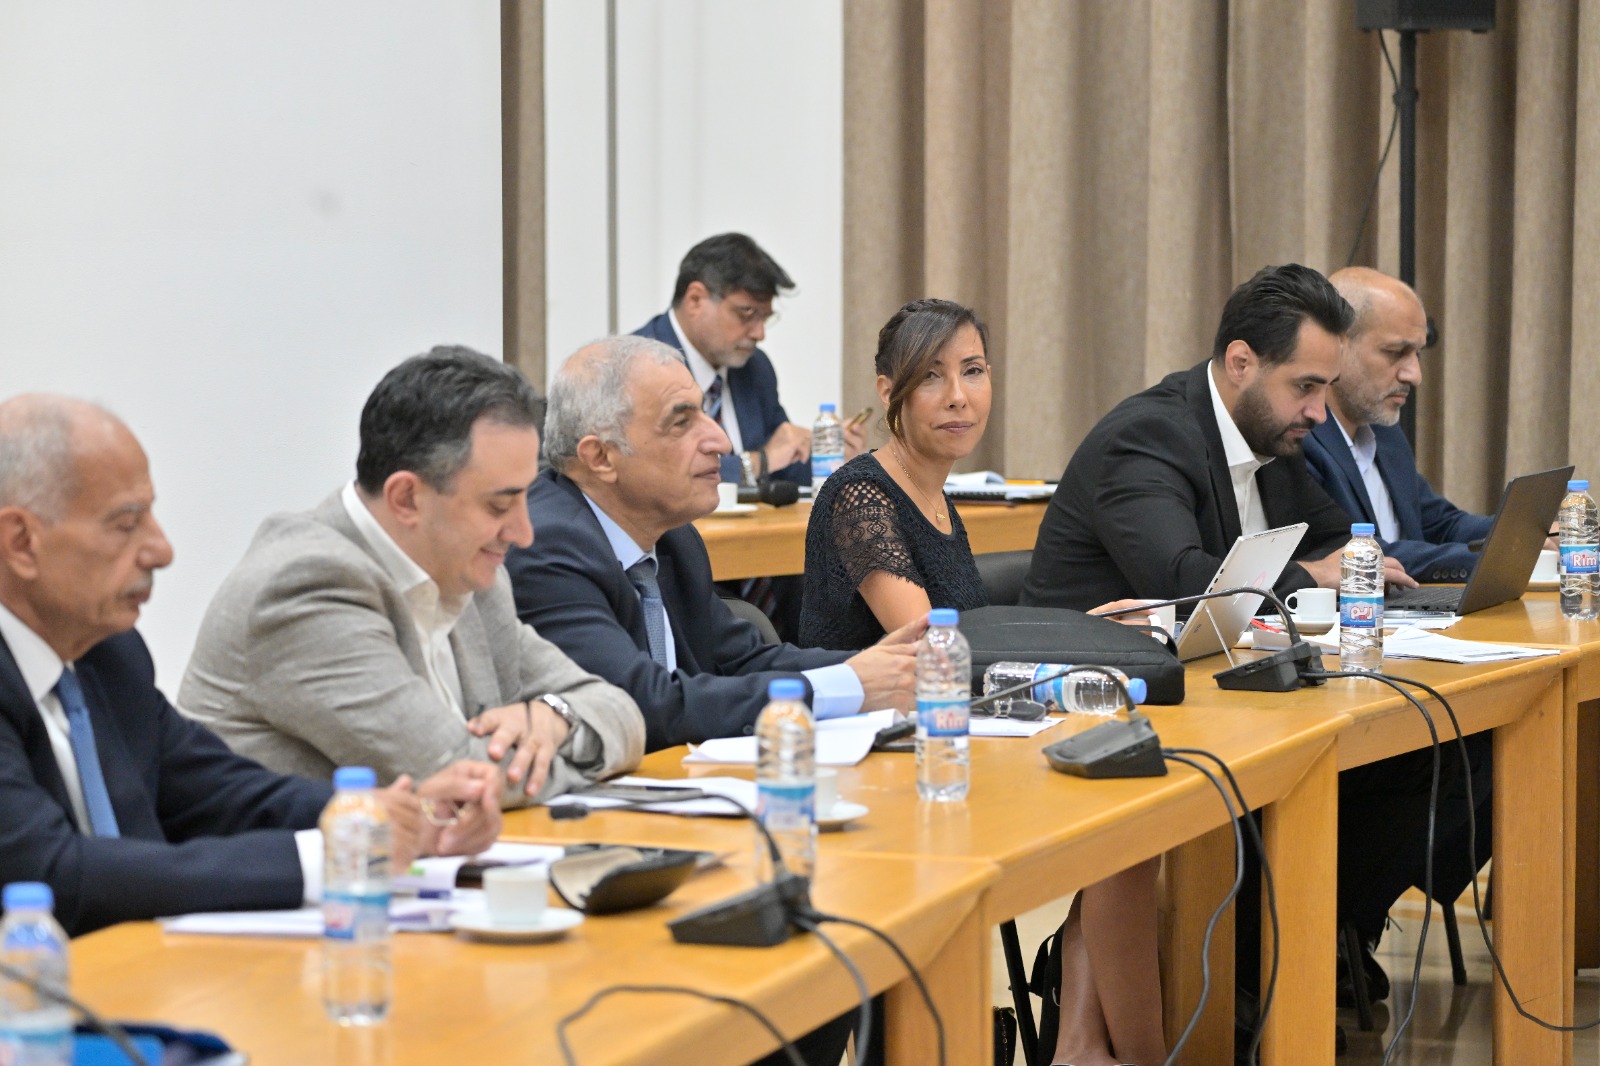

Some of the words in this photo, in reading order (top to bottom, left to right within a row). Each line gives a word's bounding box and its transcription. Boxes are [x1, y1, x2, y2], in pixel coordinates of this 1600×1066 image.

[1573, 554, 1597, 567] Rim
[1350, 606, 1373, 621] ريم
[936, 711, 967, 729] Rim
